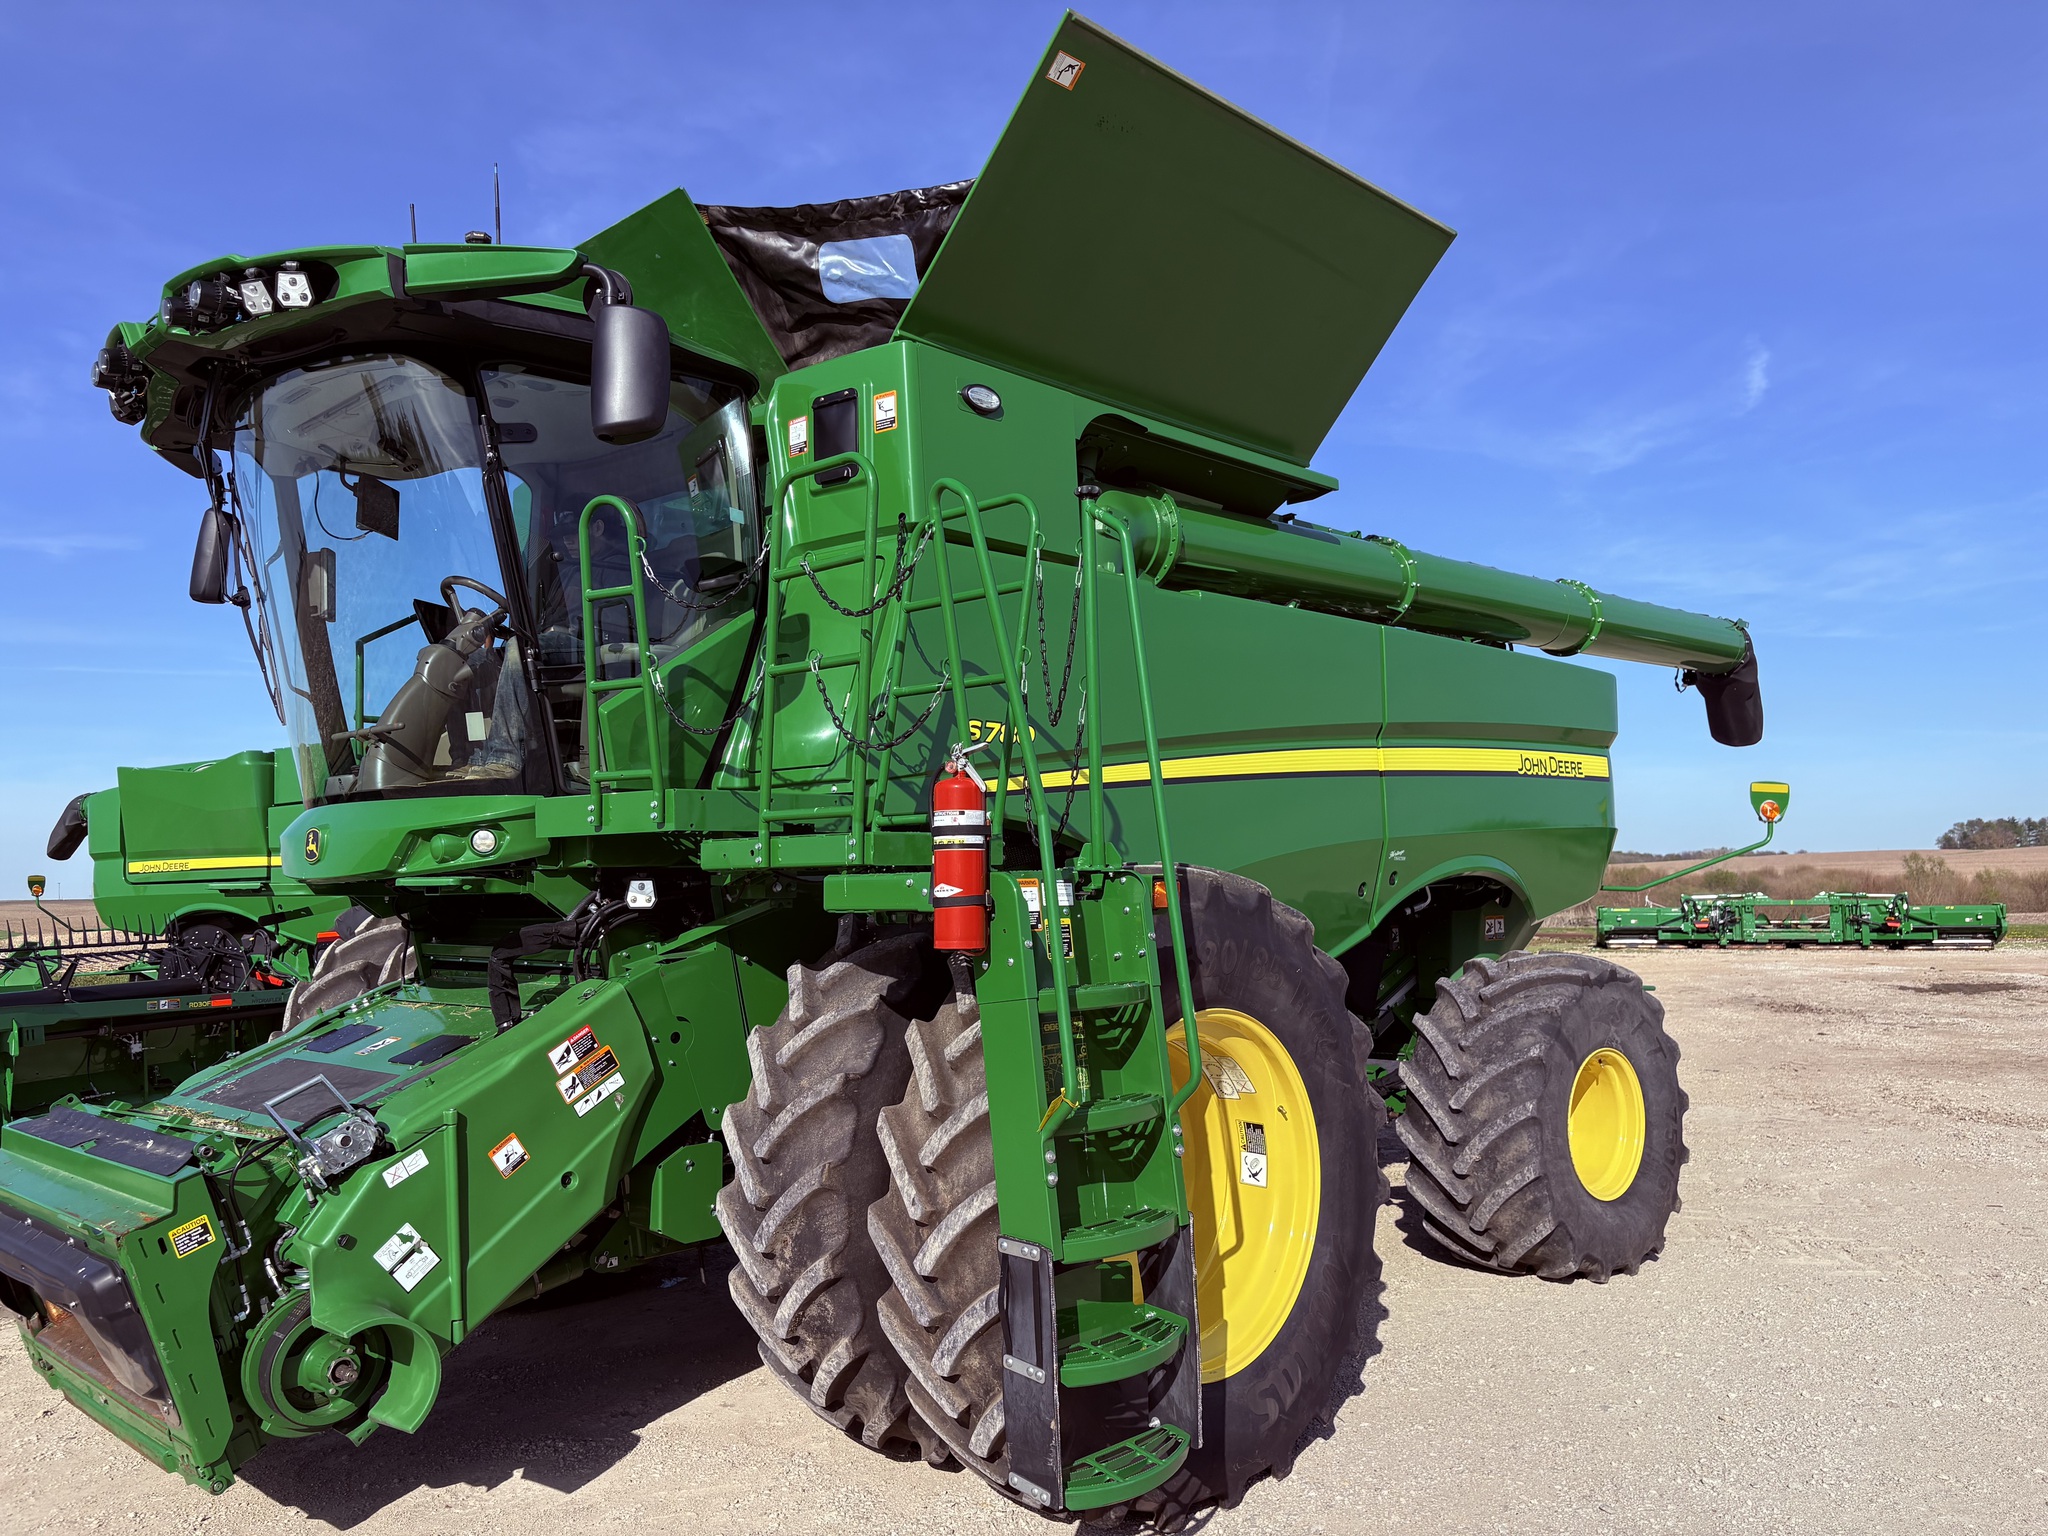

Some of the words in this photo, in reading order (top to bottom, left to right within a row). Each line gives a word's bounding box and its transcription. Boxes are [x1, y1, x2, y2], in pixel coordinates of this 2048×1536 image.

[1518, 754, 1548, 773] JOHN
[1549, 756, 1584, 775] DEERE
[140, 863, 161, 872] JOHN
[162, 861, 190, 871] DEERE
[1238, 1121, 1246, 1144] CAUTION
[176, 1216, 206, 1234] CAUTION
